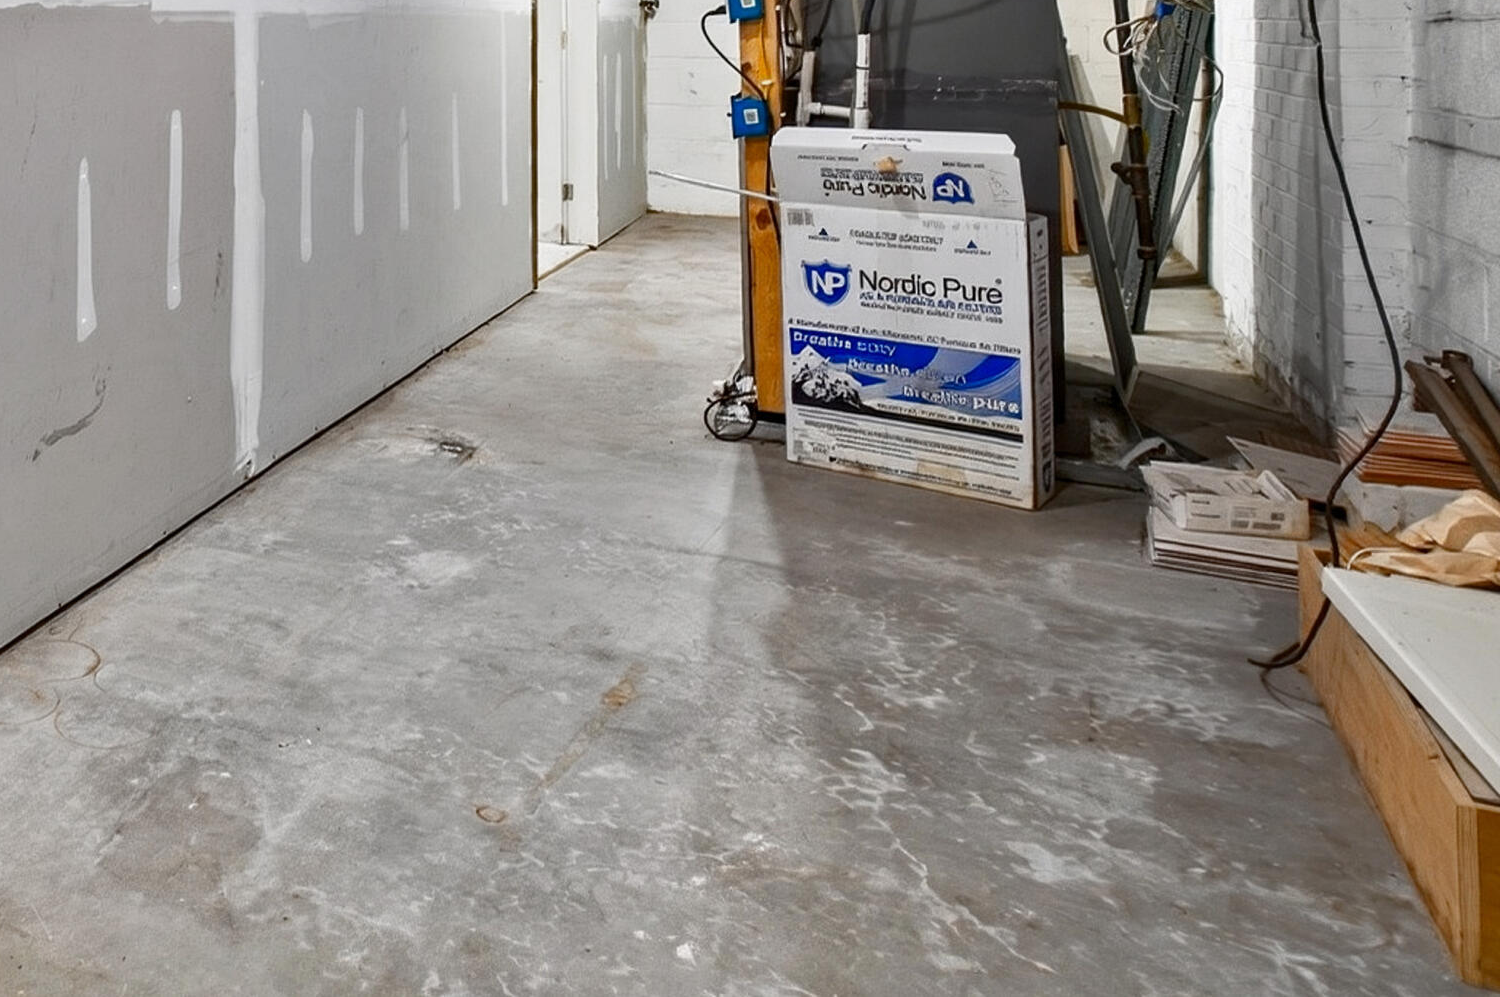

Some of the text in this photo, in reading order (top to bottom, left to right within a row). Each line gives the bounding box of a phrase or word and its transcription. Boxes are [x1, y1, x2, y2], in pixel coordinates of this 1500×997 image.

[868, 179, 927, 200] Nordic
[811, 270, 845, 295] NP
[859, 269, 936, 297] Nordic
[943, 277, 1003, 304] Pure
